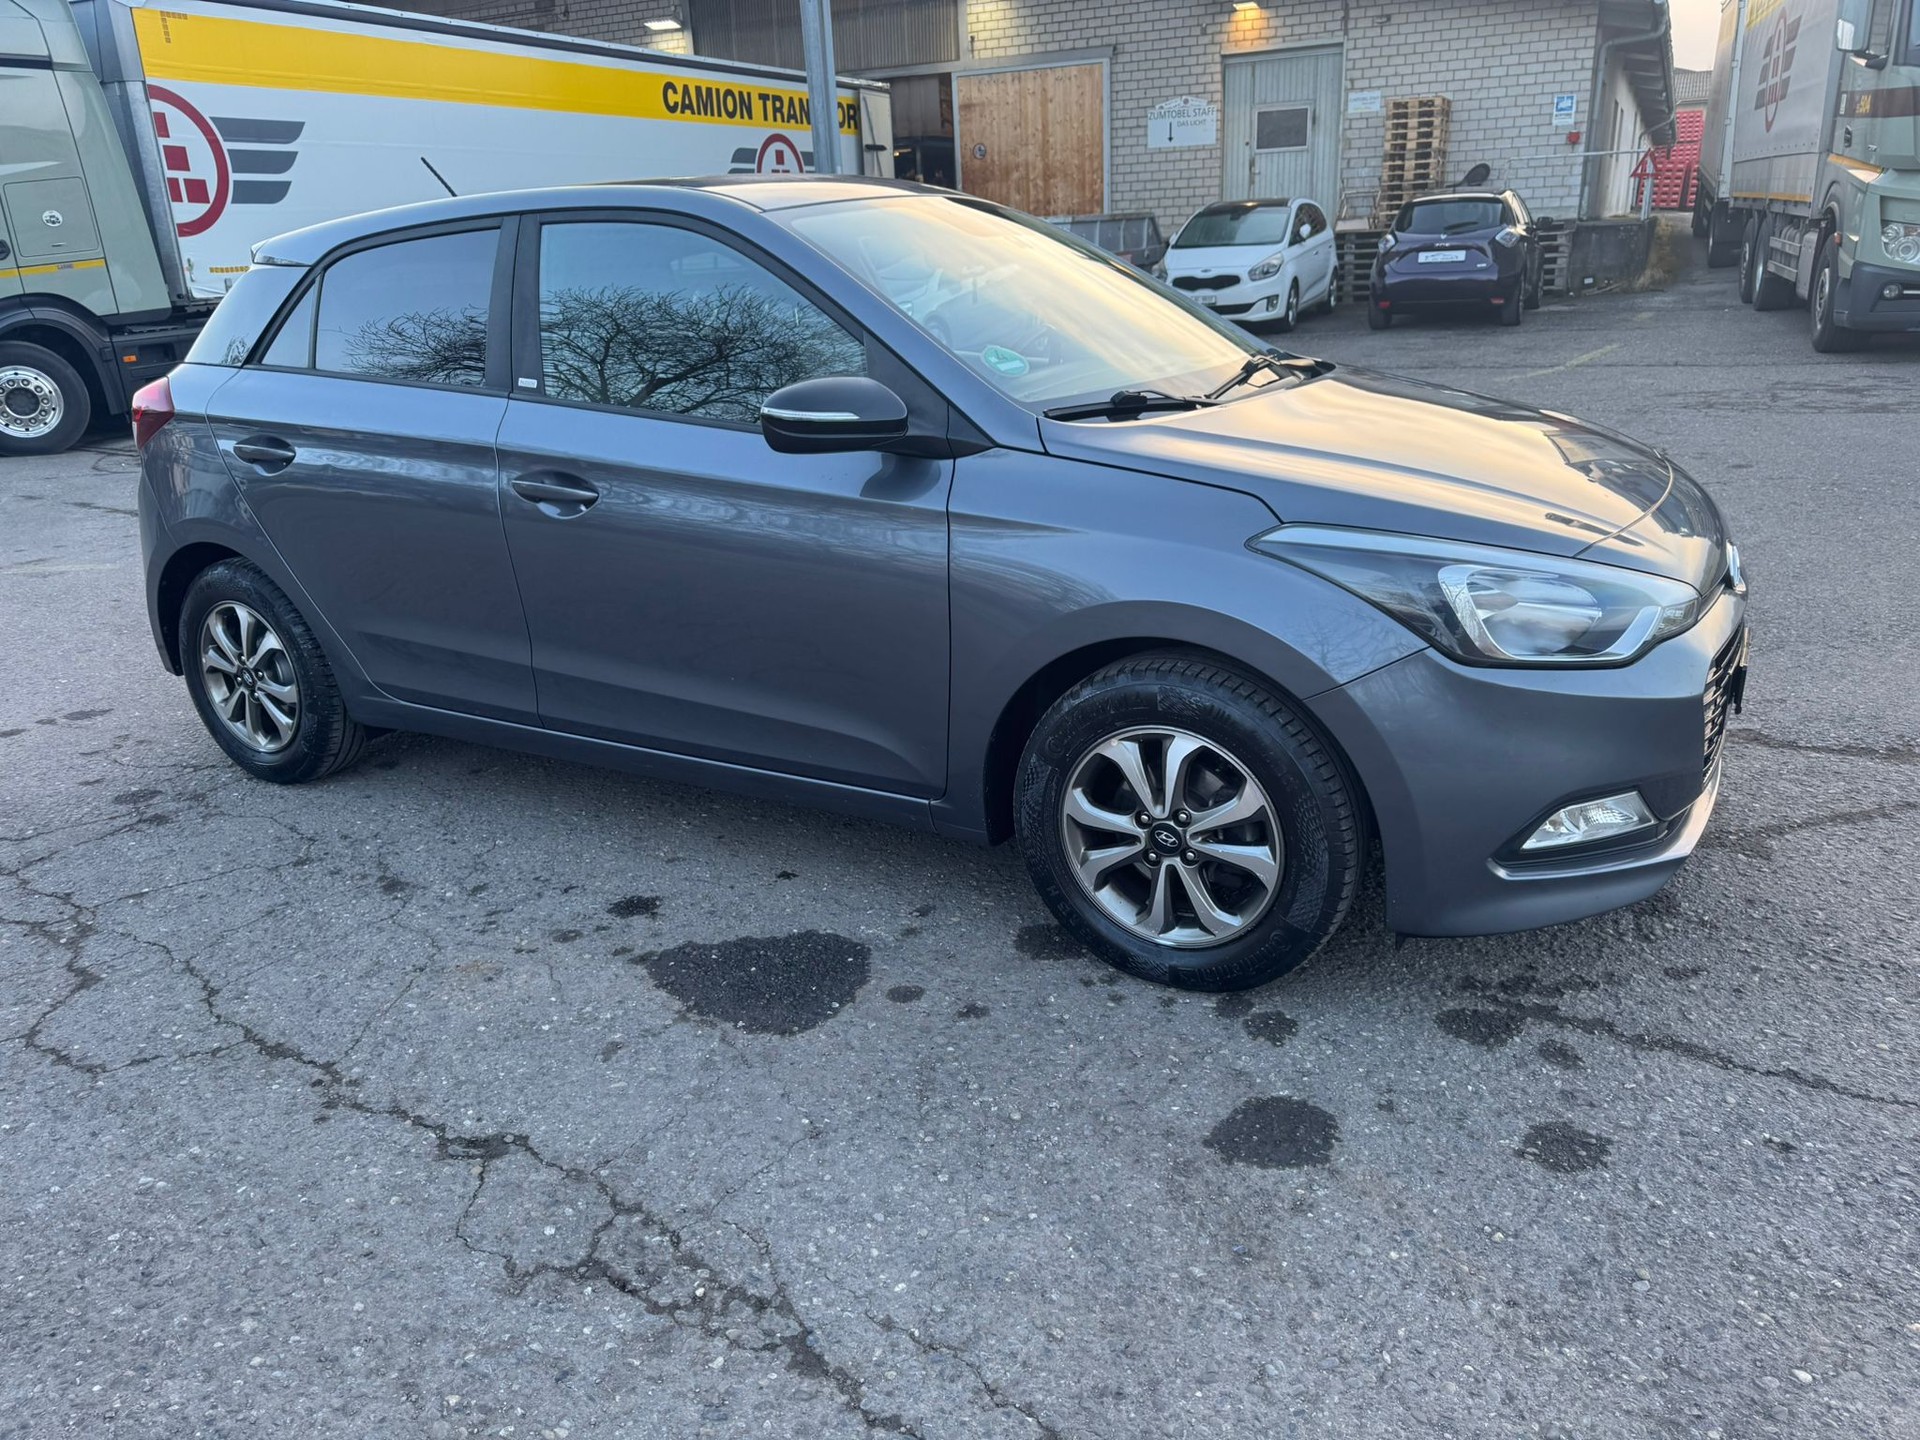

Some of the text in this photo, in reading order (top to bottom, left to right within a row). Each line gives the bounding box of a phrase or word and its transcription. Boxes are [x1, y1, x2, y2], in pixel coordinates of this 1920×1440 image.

[662, 81, 753, 120] CAMION
[1148, 106, 1216, 120] ZUMTOBEL STAFF
